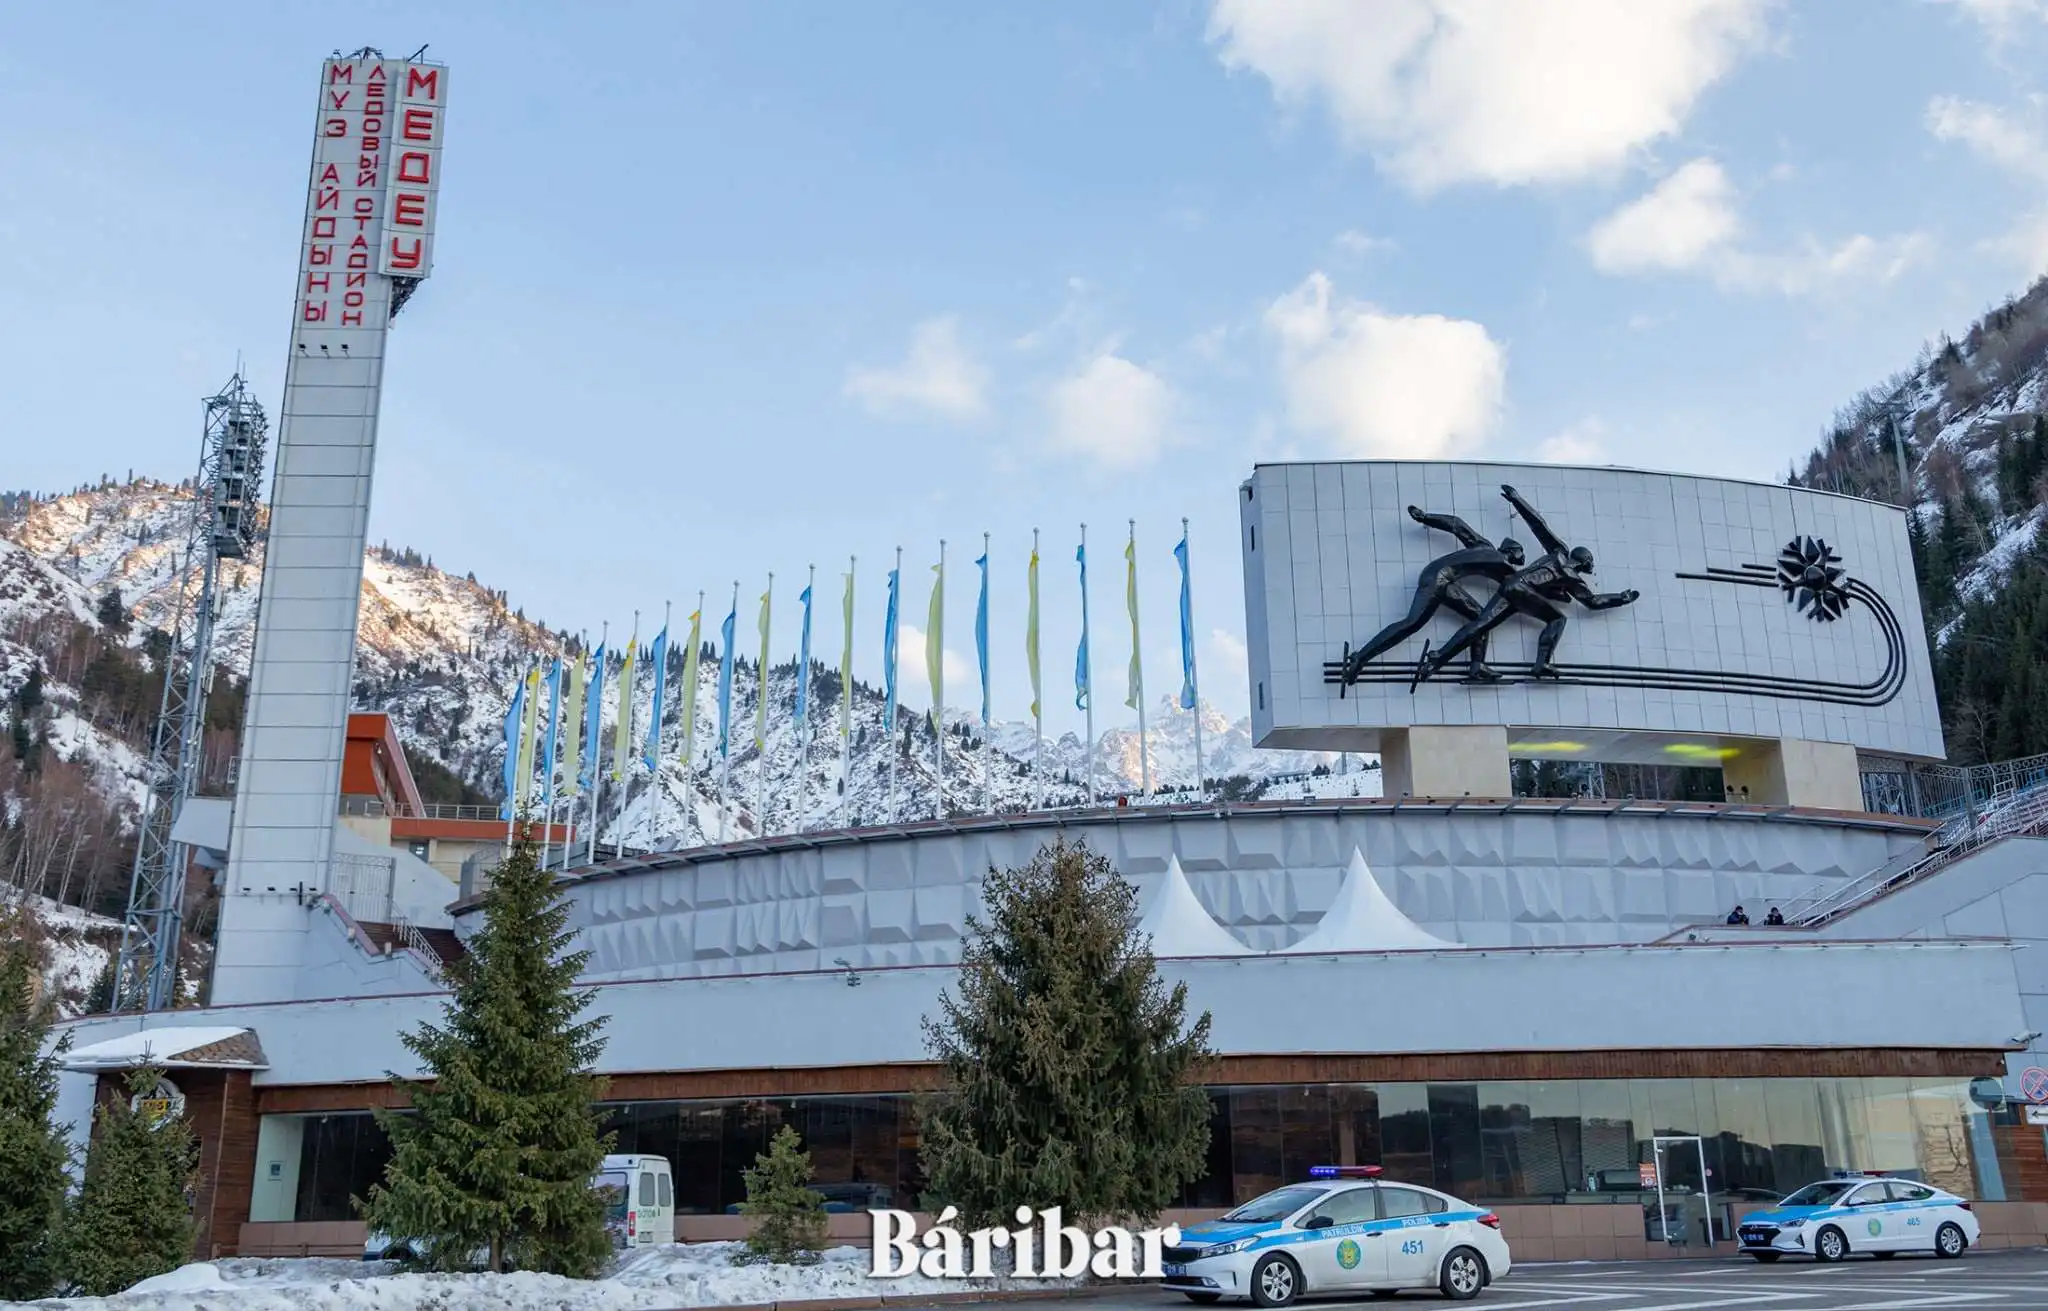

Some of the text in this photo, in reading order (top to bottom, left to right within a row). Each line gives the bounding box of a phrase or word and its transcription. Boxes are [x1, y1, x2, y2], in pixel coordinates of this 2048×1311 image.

[304, 163, 339, 322] АЙДЫНЫ
[341, 64, 386, 326] ЛЕДОВЫЙ СТАДИОН
[391, 67, 437, 269] МЕДЕУ
[1402, 1240, 1424, 1254] 451
